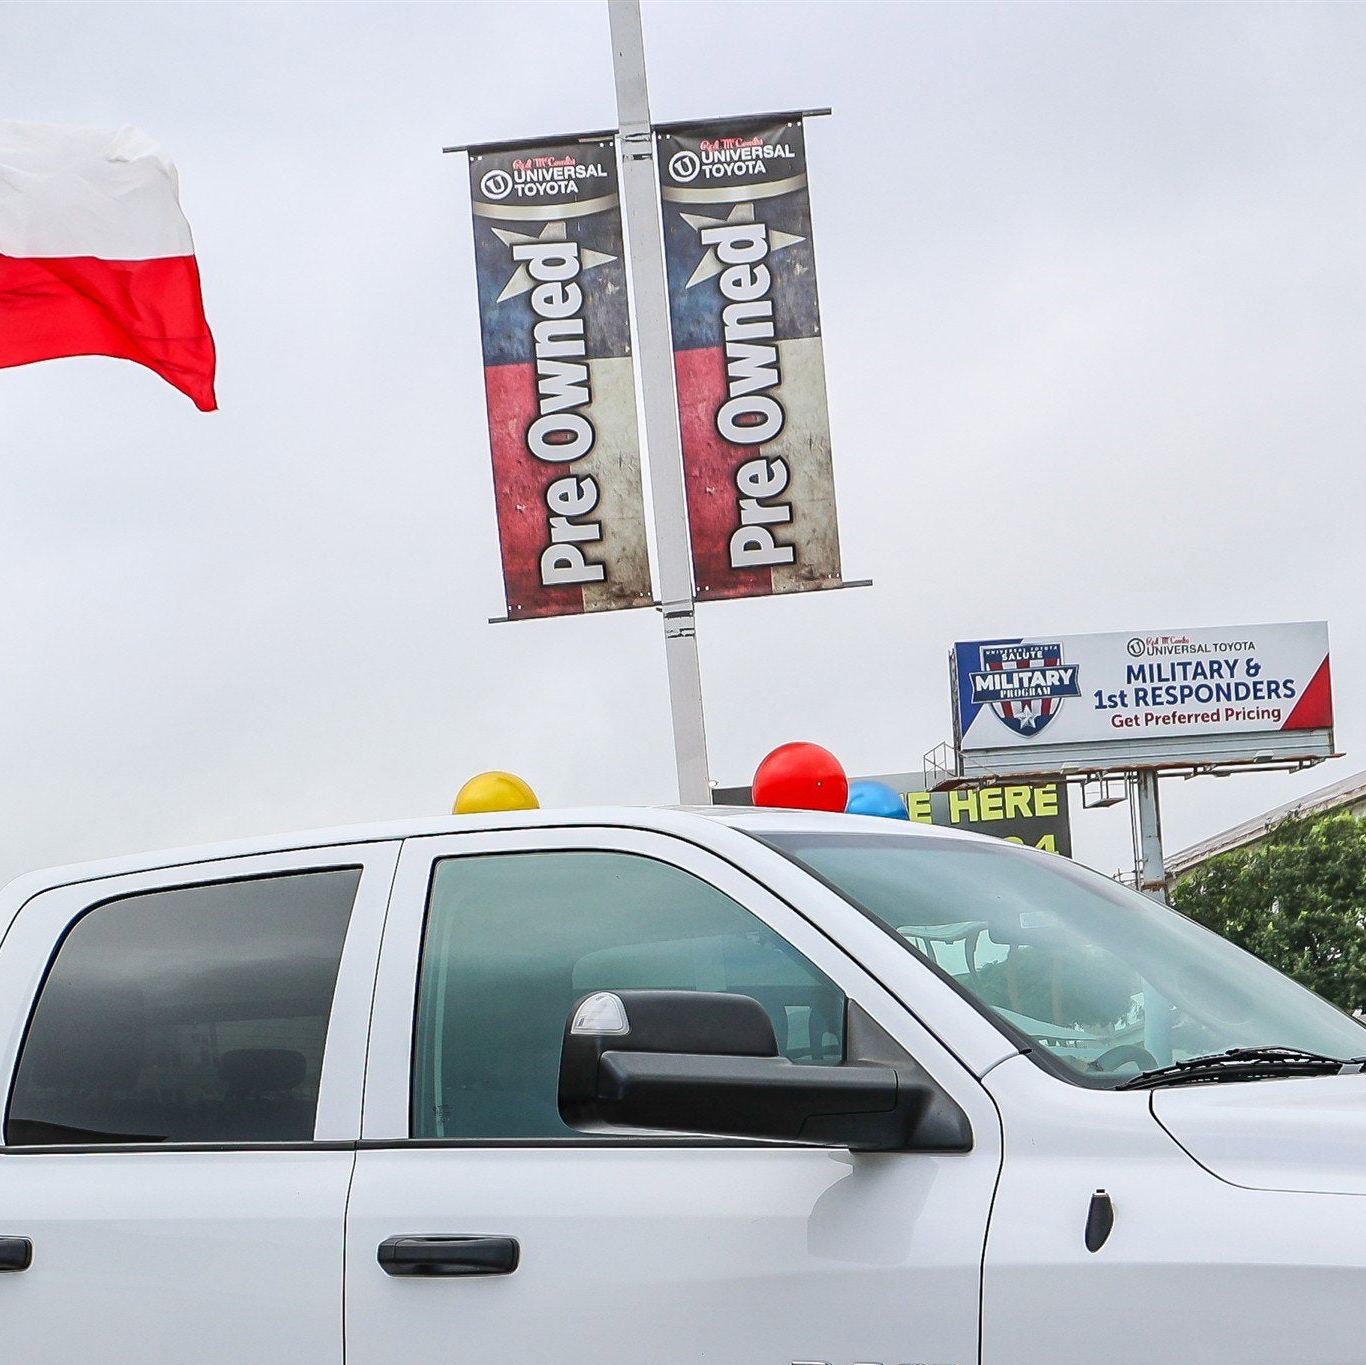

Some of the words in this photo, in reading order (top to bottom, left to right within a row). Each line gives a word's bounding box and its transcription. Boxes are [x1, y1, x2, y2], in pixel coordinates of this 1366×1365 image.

[701, 144, 795, 163] UNIVERSAL
[514, 164, 607, 183] UNIVERSAL
[702, 160, 766, 178] TOYOTA
[515, 180, 578, 197] TOYOTA
[701, 223, 783, 444] Owned
[513, 241, 594, 462] Owned
[730, 457, 793, 568] Pre
[541, 476, 605, 586] Pre
[1001, 651, 1043, 661] SALUTE
[1147, 644, 1211, 656] UNIVERSAL
[1213, 641, 1255, 652] TOYOTA
[975, 669, 1073, 691] MILITARY
[1126, 658, 1239, 685] MILITARY
[1245, 657, 1261, 677] &
[1000, 687, 1051, 698] PROGRAM
[1094, 690, 1129, 710] 1st
[1134, 679, 1296, 707] RESPONDERS
[1111, 714, 1140, 728] Get
[1145, 708, 1220, 726] Preferred
[1225, 706, 1281, 723] Pricing
[948, 783, 1059, 823] HERE
